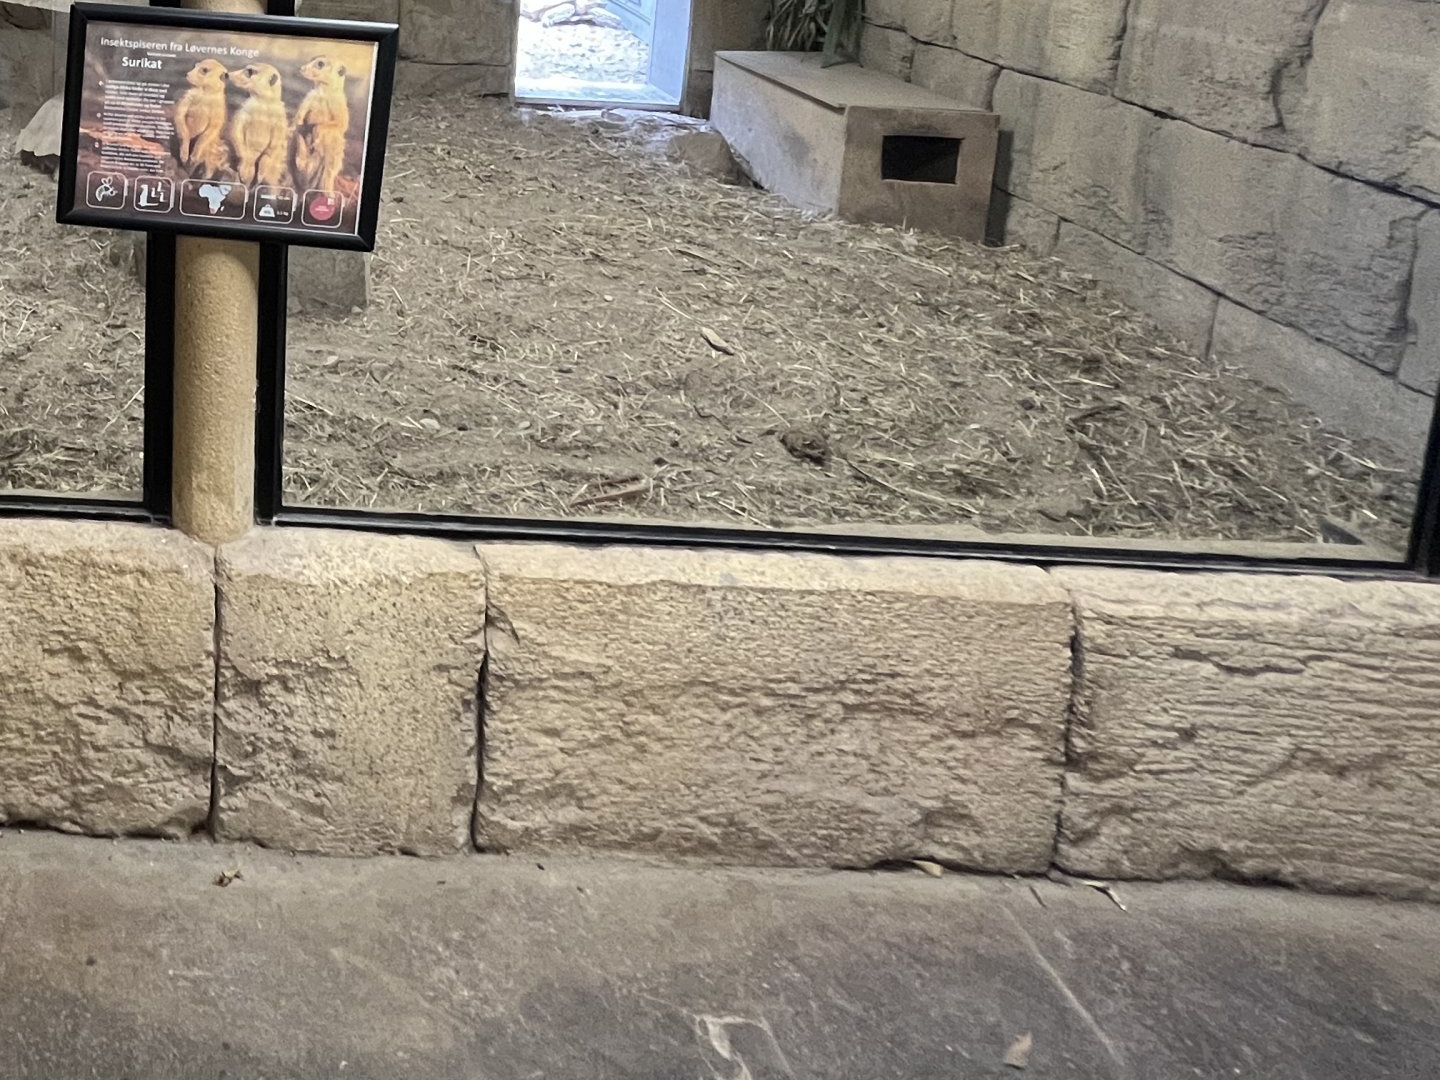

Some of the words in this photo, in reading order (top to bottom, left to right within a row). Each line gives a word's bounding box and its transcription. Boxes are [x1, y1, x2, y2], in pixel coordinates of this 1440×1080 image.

[100, 37, 168, 51] Insektspiseren
[169, 41, 183, 52] fra
[185, 42, 227, 55] Løvernes
[230, 46, 259, 59] Konge
[122, 56, 163, 69] Surikat
